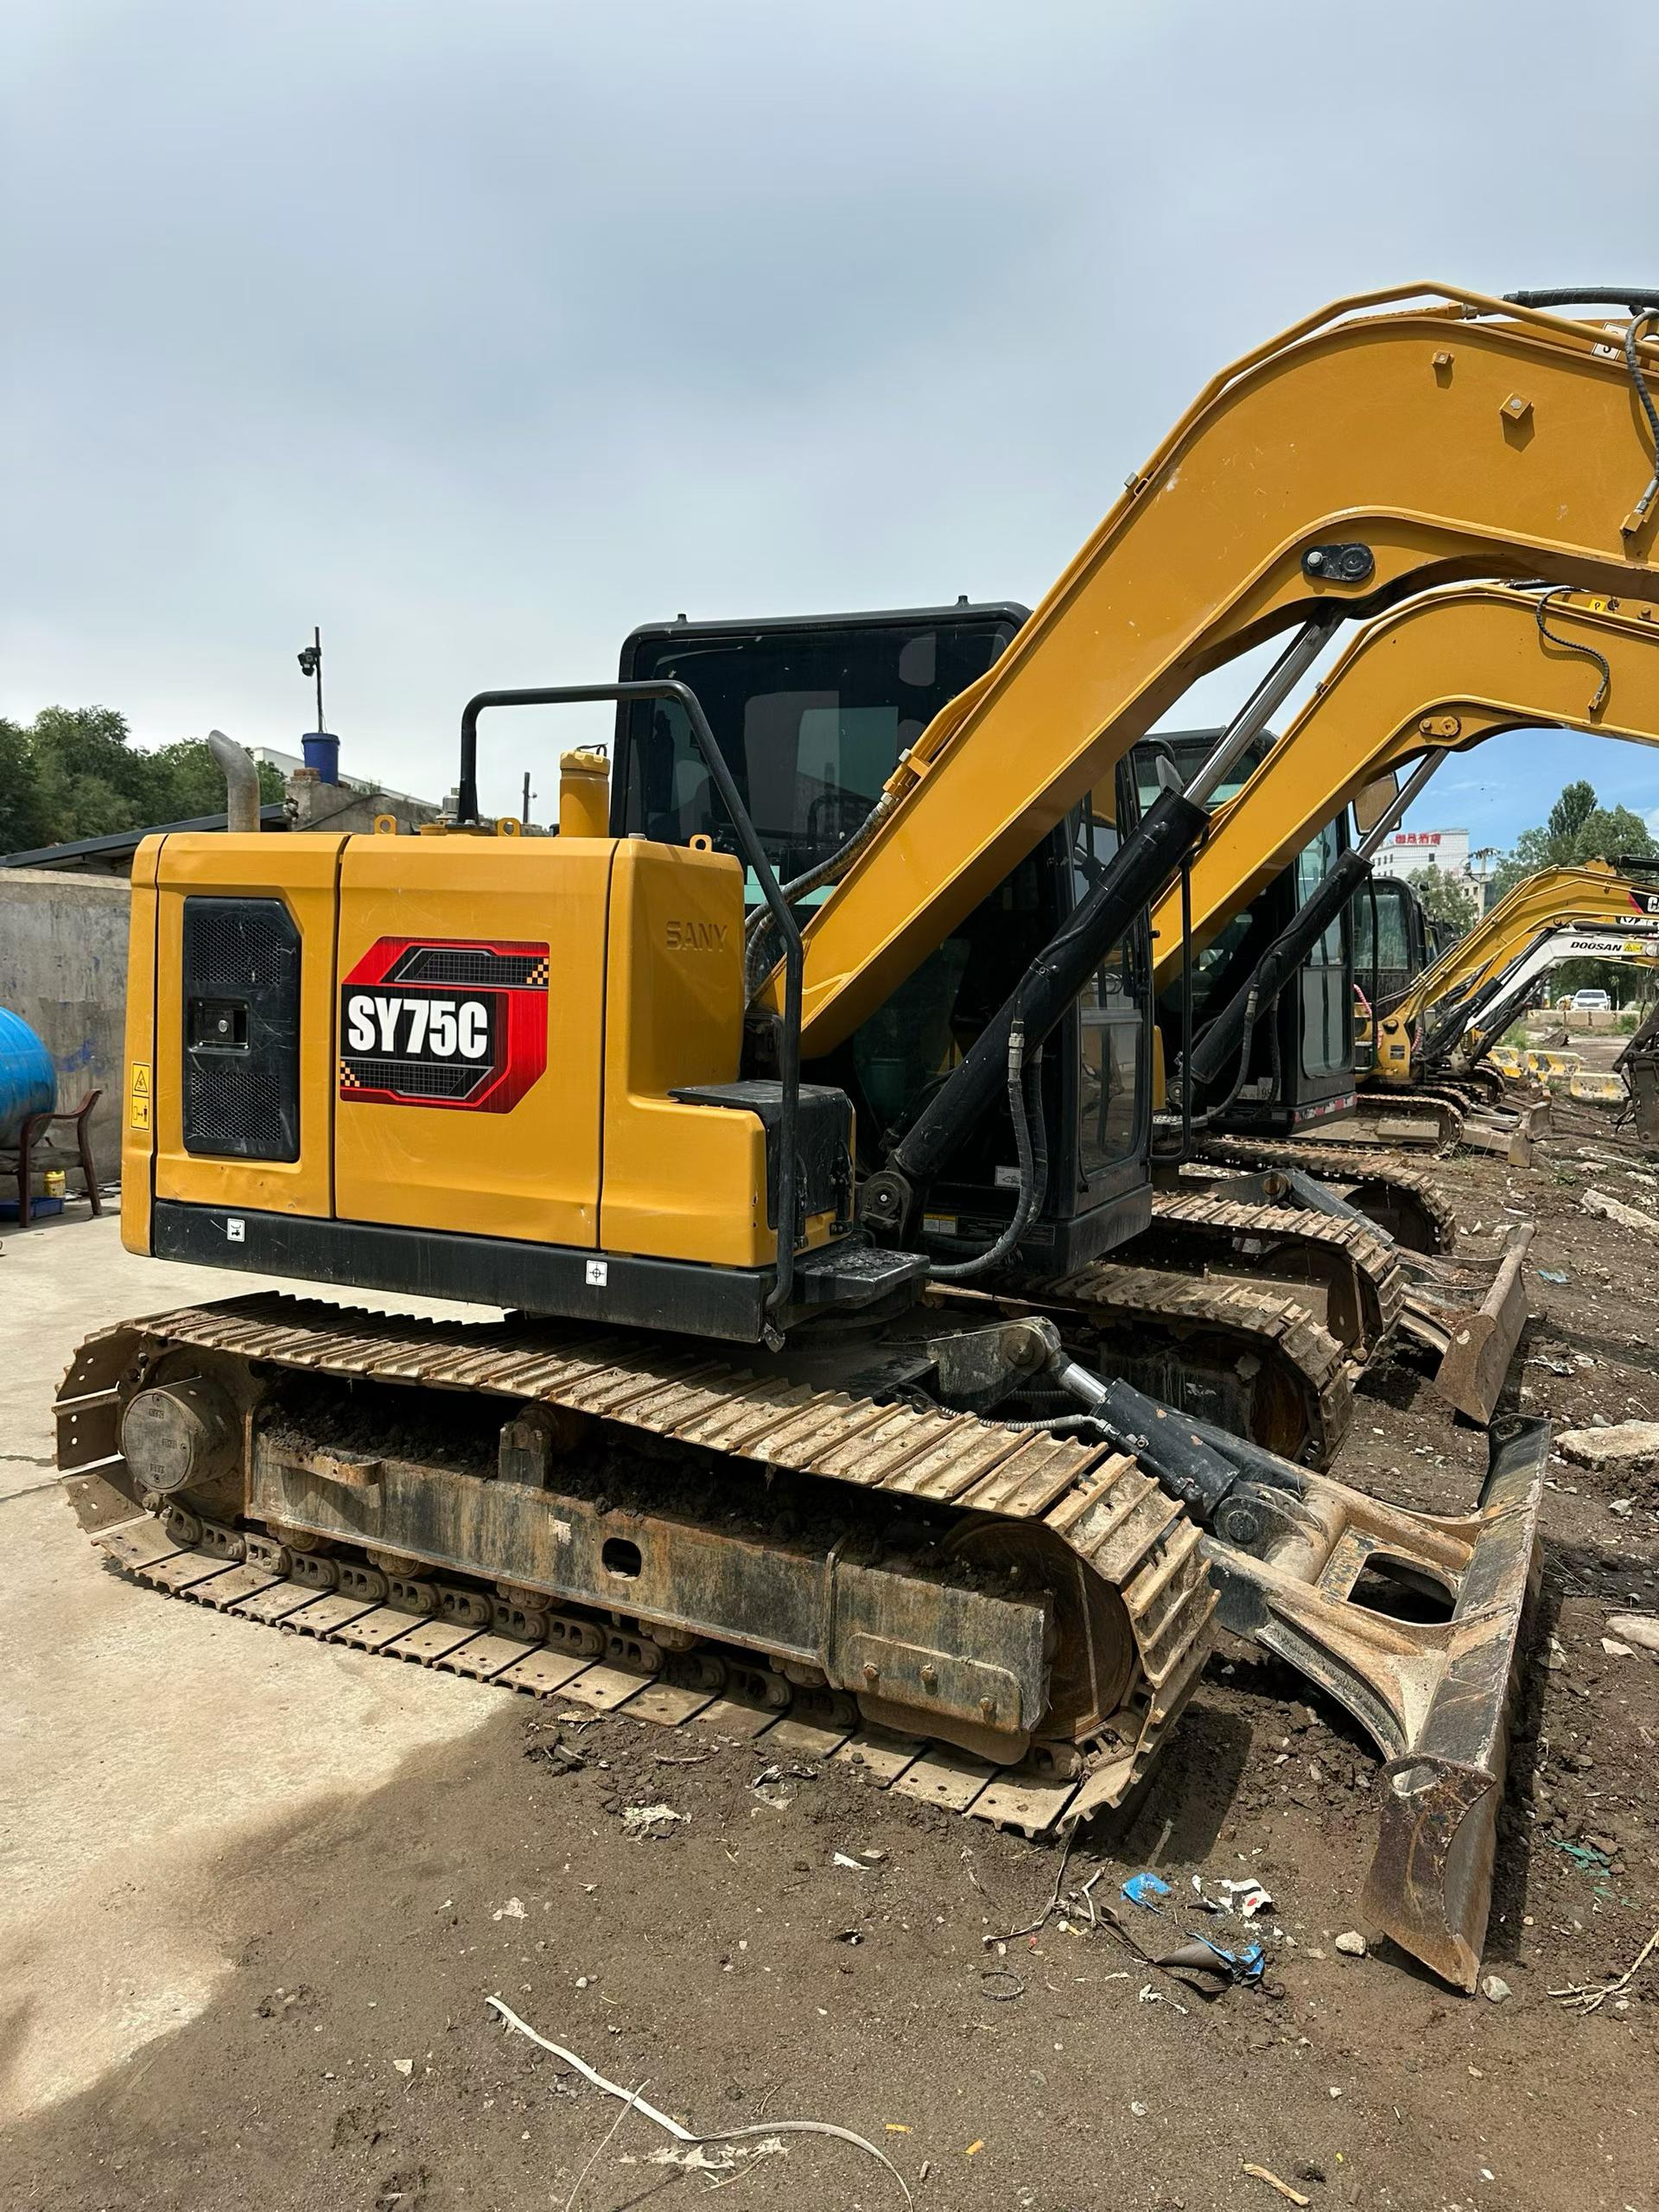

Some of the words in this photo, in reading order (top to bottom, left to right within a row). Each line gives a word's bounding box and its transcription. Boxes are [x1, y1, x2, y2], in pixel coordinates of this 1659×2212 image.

[1647, 896, 1659, 912] C
[666, 920, 728, 951] SANY
[1570, 941, 1623, 951] DOOSAN
[348, 995, 488, 1059] SY75C
